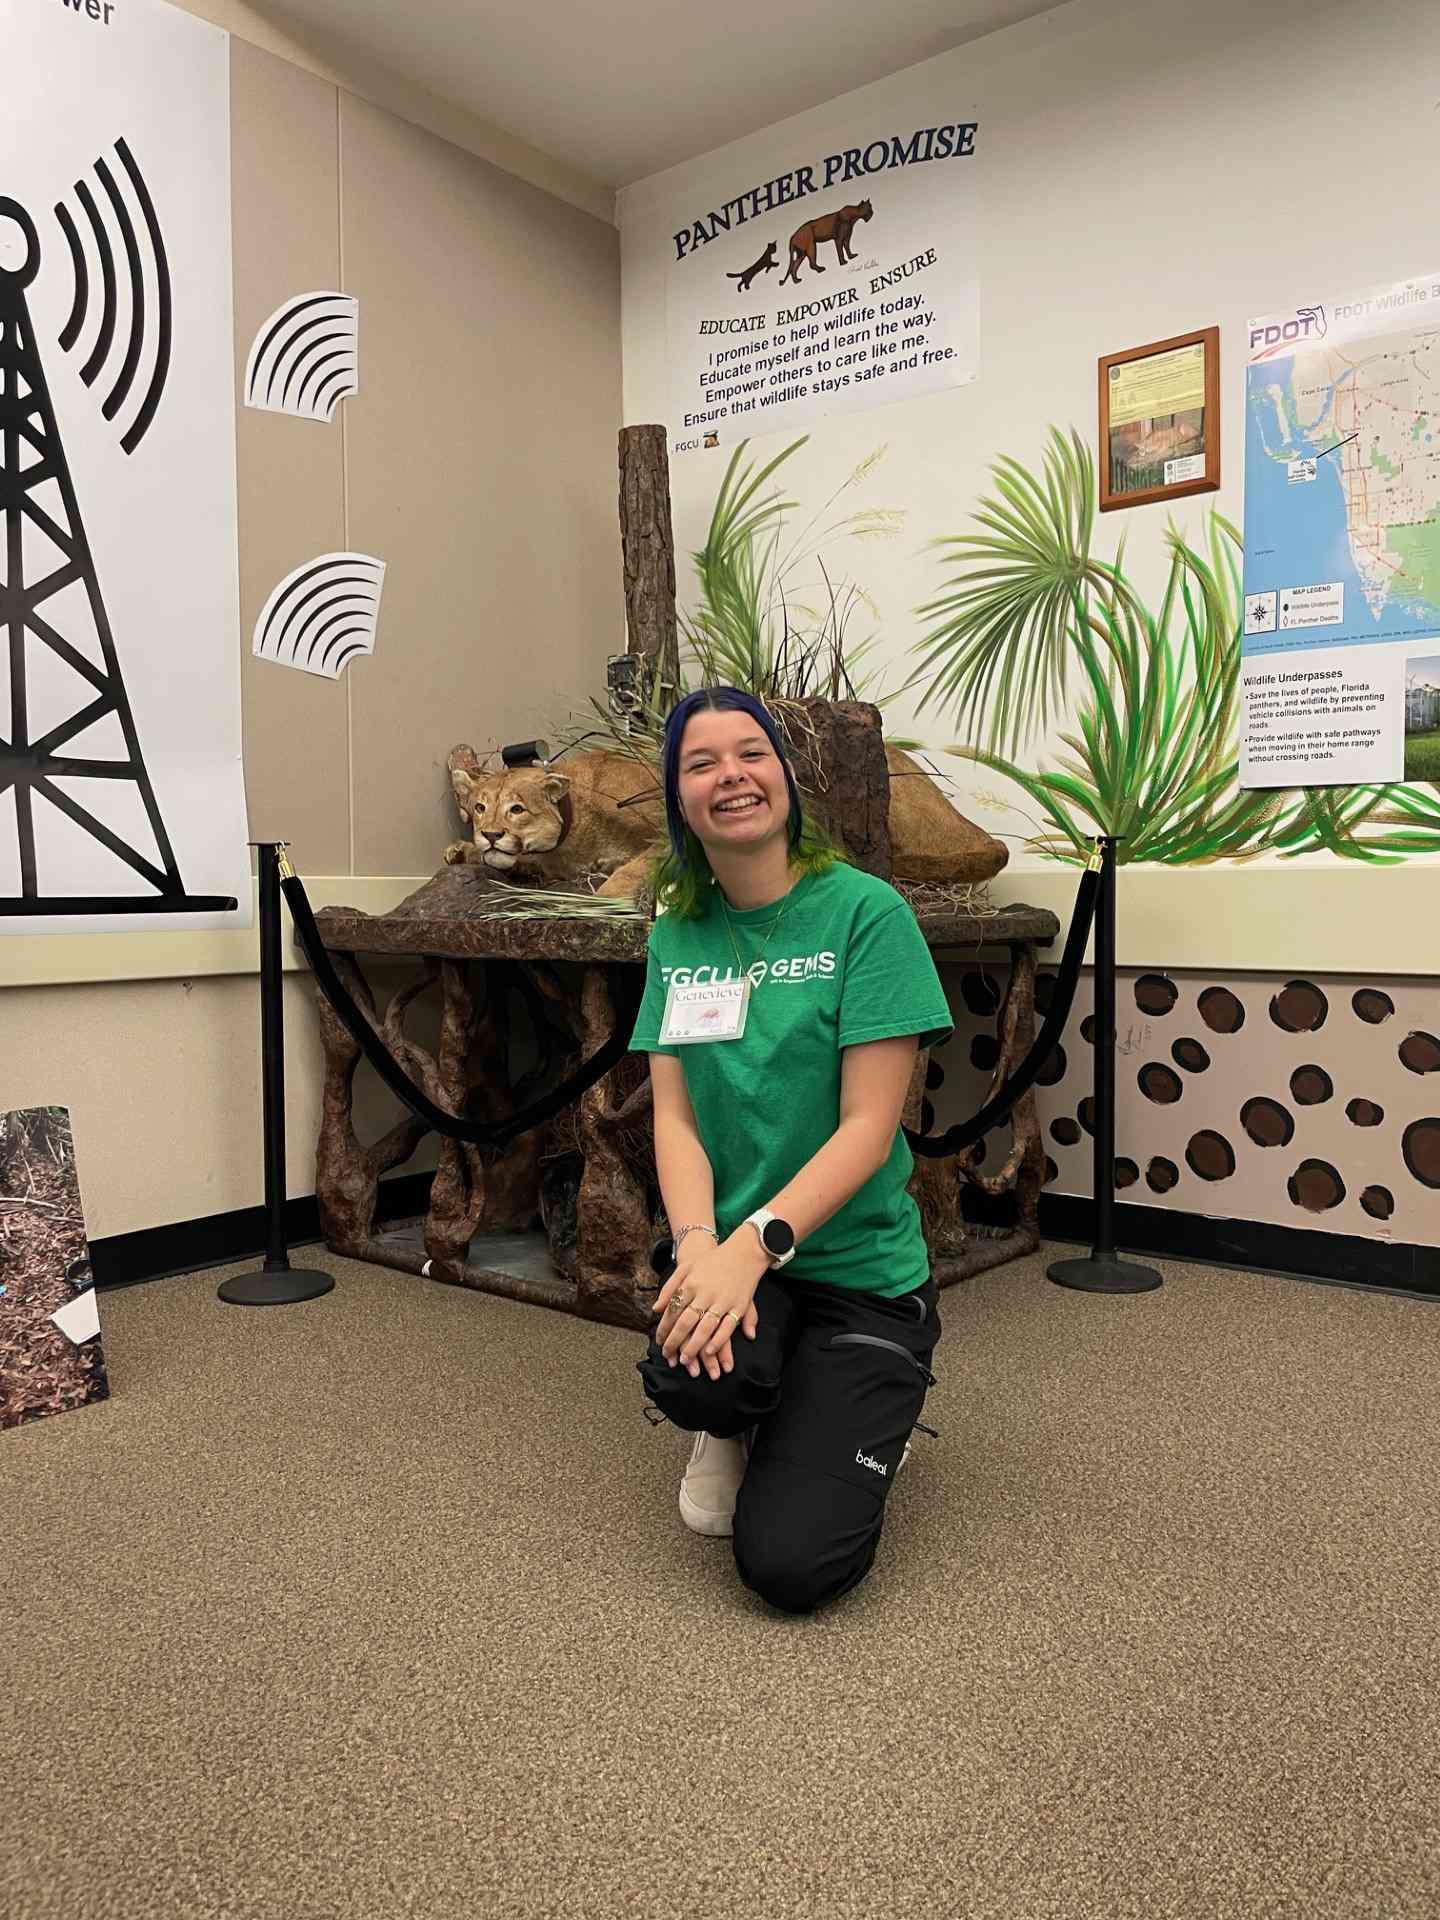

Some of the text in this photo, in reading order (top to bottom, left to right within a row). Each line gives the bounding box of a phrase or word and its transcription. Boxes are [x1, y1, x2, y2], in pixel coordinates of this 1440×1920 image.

[672, 122, 978, 260] PANTHER PROMISE
[699, 248, 937, 335] EDUCATE EMPOWER ENSURE
[1335, 300, 1373, 320] FDOT
[1376, 288, 1426, 309] Wildlife
[709, 294, 925, 366] I promise to help wildlife today.
[1250, 316, 1315, 348] FDOT
[700, 311, 936, 386] Educate myself and learn the way.
[705, 334, 929, 403] Empower others to care like me.
[684, 347, 958, 427] Ensure that wildlife stays safe and free.
[675, 439, 699, 453] FGCU
[1307, 586, 1332, 594] LEGEND
[1243, 670, 1343, 686] Wildlife Underpasses
[1249, 692, 1267, 700] Save
[1268, 690, 1279, 698] the
[1281, 689, 1299, 697] lives
[1301, 687, 1309, 695] of
[1341, 683, 1370, 692] Florida
[1284, 699, 1298, 707] and
[1300, 697, 1328, 706] wildlife
[1330, 696, 1339, 705] by
[1341, 693, 1385, 704] preventing
[1249, 711, 1273, 720] vehicle
[1275, 708, 1312, 718] collisions
[1314, 706, 1330, 715] with
[1332, 704, 1363, 714] animals
[1248, 728, 1381, 744] Provide wildlife with safe pathways
[1248, 740, 1375, 753] when moving in their home range
[1248, 755, 1274, 763] without
[1275, 752, 1309, 762] crossing
[661, 951, 836, 987] FGCU GEMS
[674, 987, 741, 1001] Genevieve
